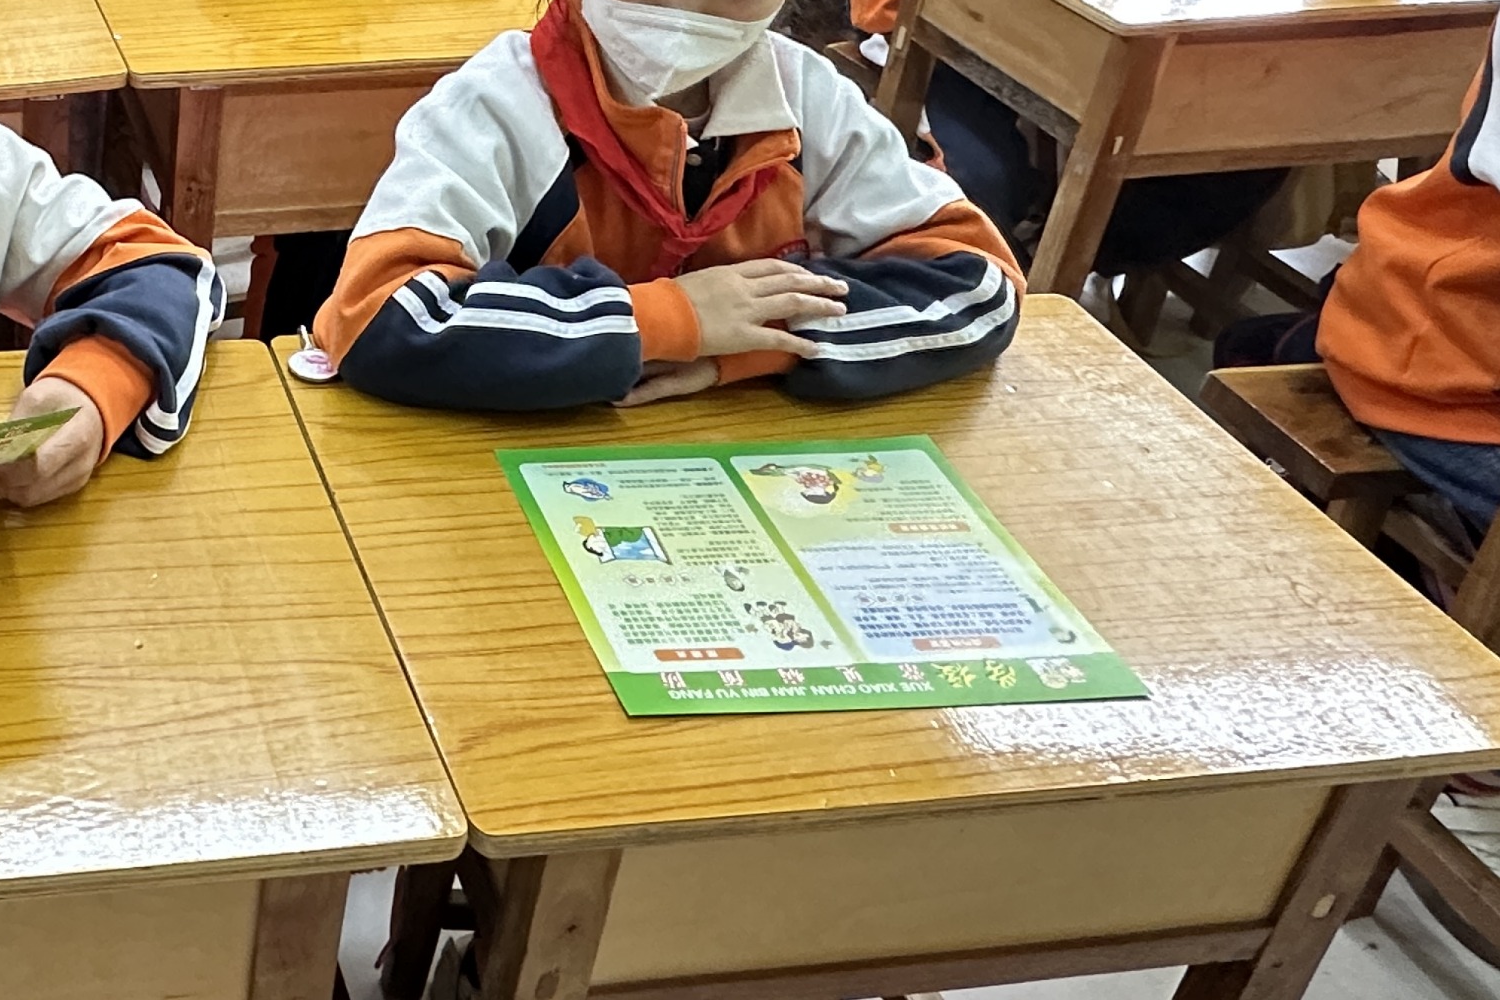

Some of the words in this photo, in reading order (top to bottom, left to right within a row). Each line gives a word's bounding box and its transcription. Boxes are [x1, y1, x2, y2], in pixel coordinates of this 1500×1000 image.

[810, 684, 856, 695] CHAN
[858, 682, 898, 693] XIAO
[668, 689, 713, 700] FANG
